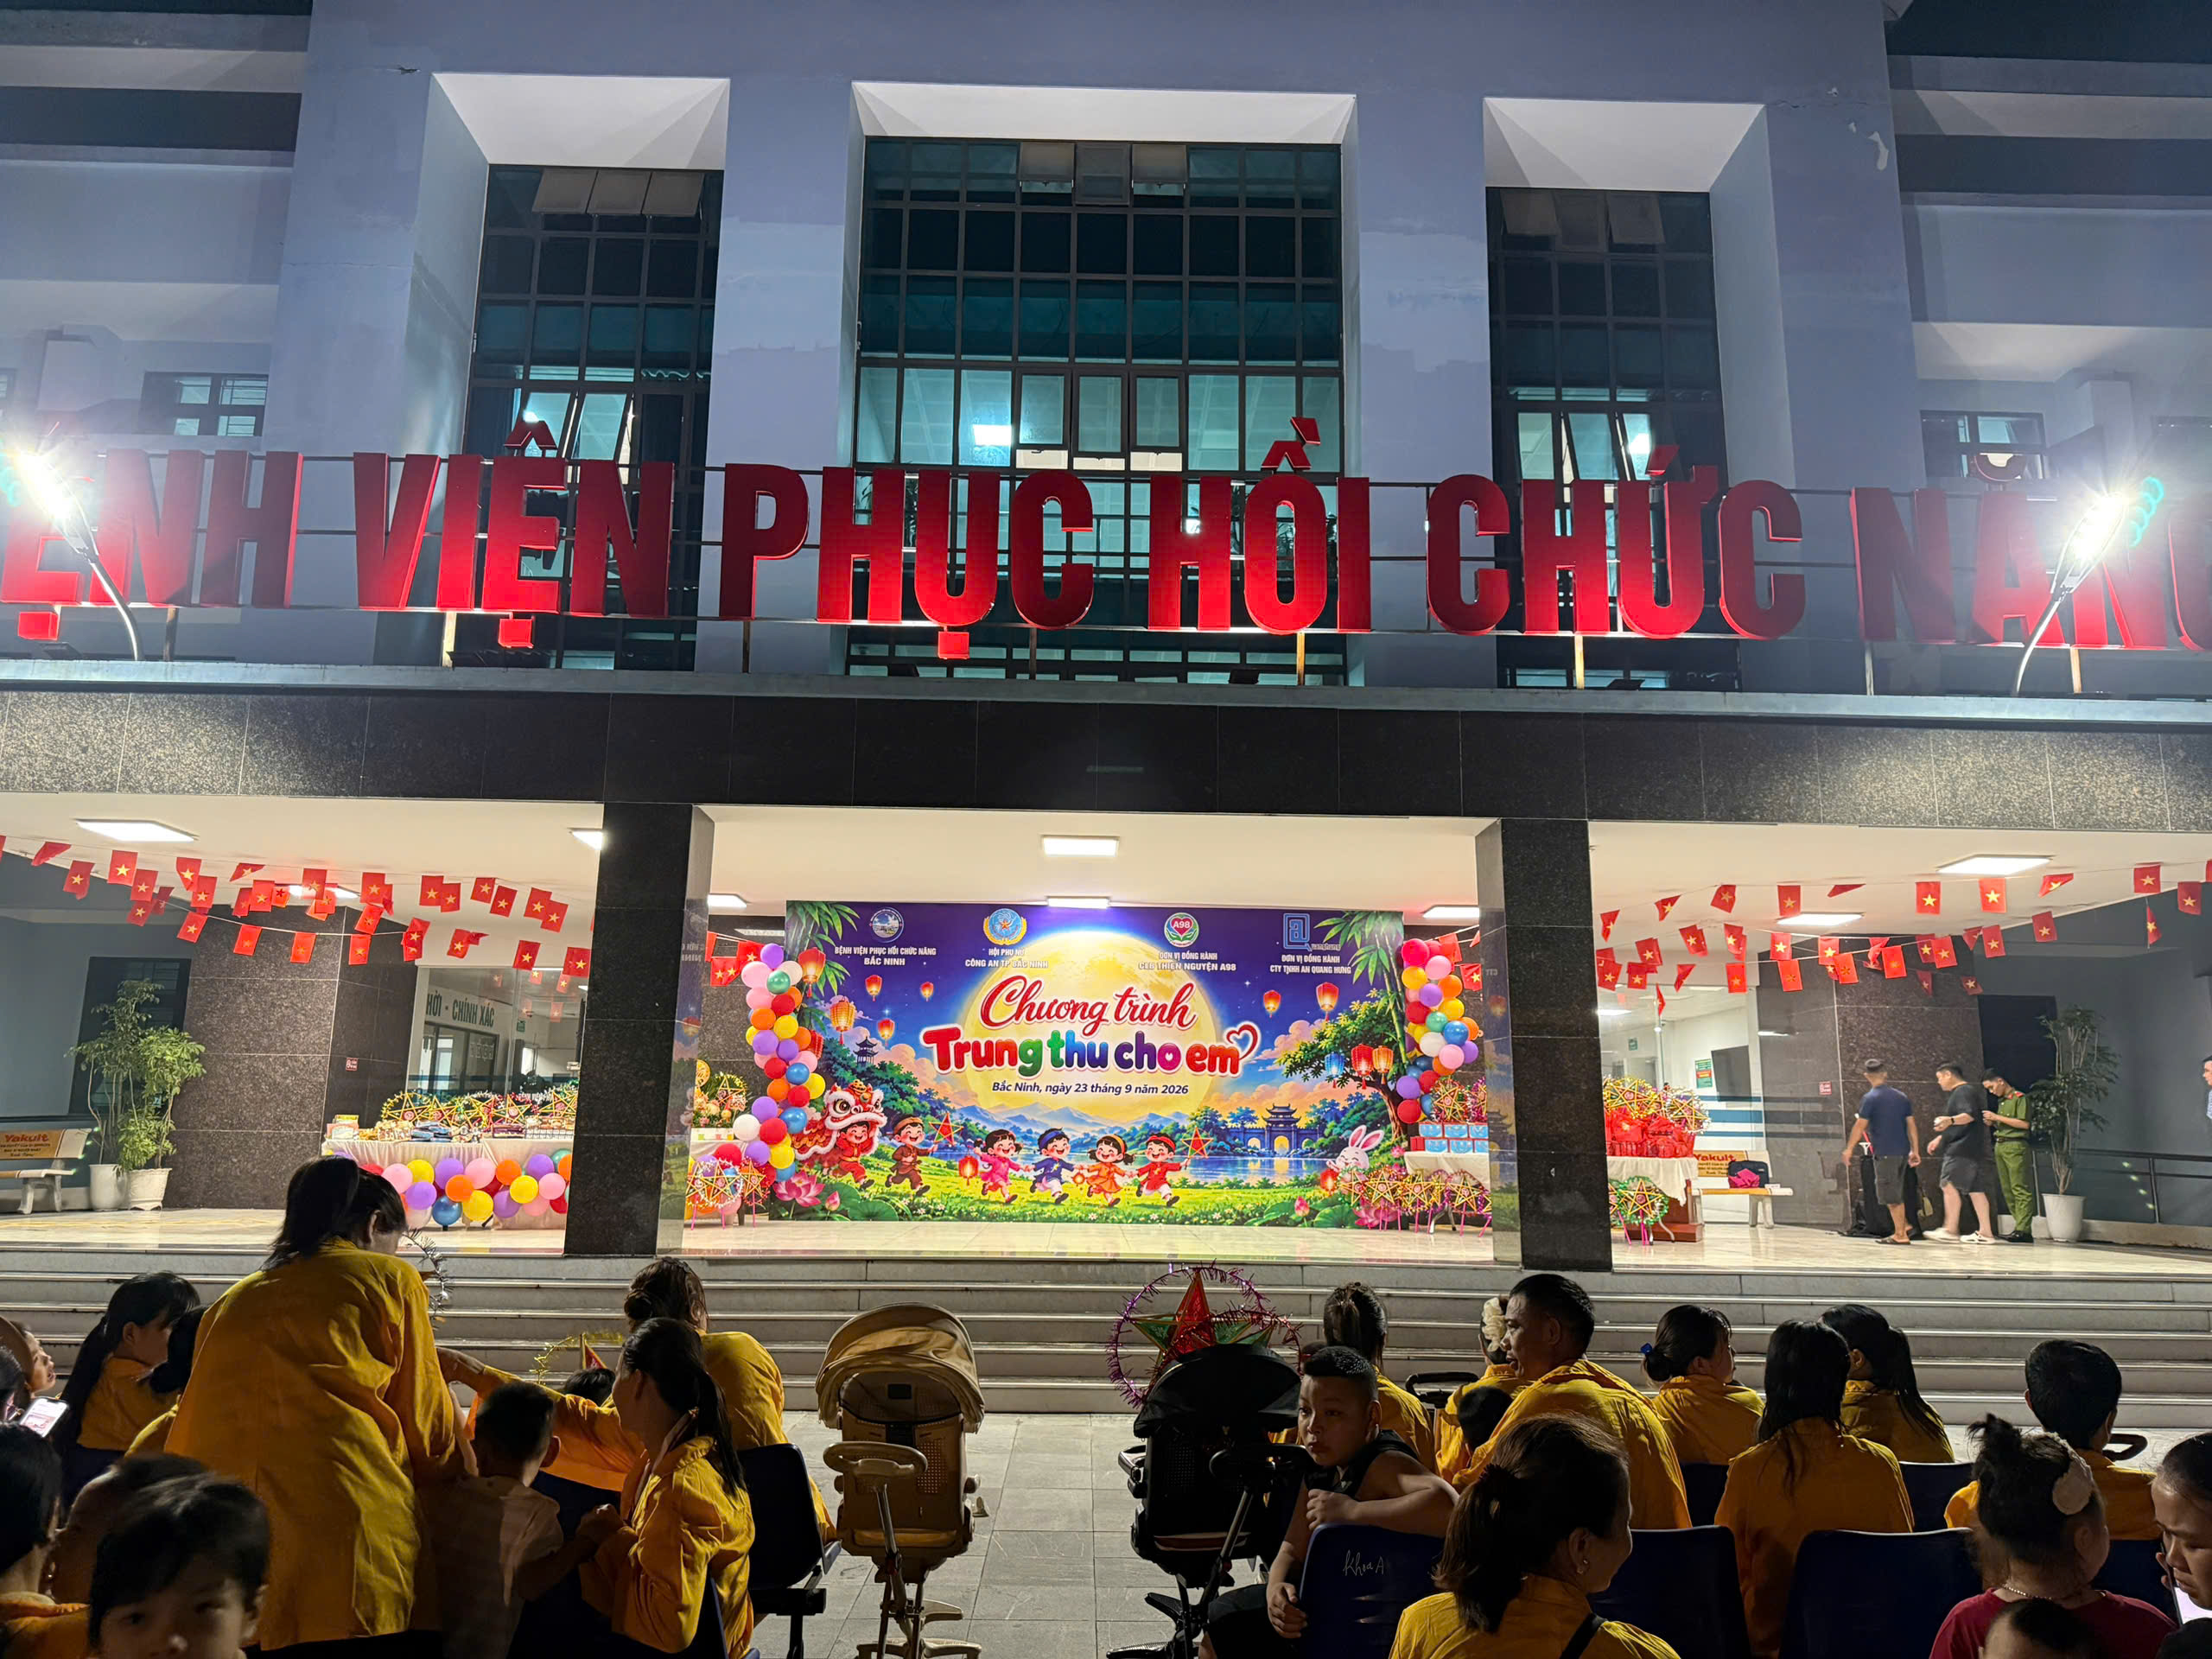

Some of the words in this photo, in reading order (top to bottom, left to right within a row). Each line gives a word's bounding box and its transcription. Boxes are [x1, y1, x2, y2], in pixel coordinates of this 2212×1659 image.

[353, 421, 675, 648] VIỆN
[719, 463, 1094, 659] PHỤC
[1147, 416, 1371, 635] HỒI
[1426, 445, 1807, 640] CHỨC
[1173, 920, 1191, 929] A98
[835, 945, 852, 956] BỆNH
[854, 945, 868, 956] VIỆN
[869, 946, 887, 957] PHỤC
[899, 945, 917, 956] CHỨC
[883, 957, 906, 966] NINH
[965, 957, 987, 968] CÔNG
[988, 959, 999, 968] AN
[1029, 960, 1049, 969] NINH
[1183, 962, 1218, 972] NGUYỆN
[1219, 963, 1236, 971] A98
[1269, 964, 1281, 973] CTY
[1300, 965, 1311, 974] AN
[1312, 965, 1333, 974] QUANG
[980, 976, 1109, 1035] Chương
[1115, 982, 1197, 1028] trình
[452, 996, 478, 1025] CHÍNH
[479, 1002, 495, 1028] XÁC
[922, 1027, 1044, 1077] Trung
[1046, 1029, 1108, 1071] thu
[1114, 1030, 1182, 1071] cho
[1185, 1041, 1241, 1075] em
[992, 1080, 1012, 1092] Bắc
[1014, 1082, 1042, 1094] Ninh,
[1046, 1082, 1072, 1095] ngày
[1074, 1083, 1088, 1093] 23
[1090, 1083, 1122, 1096] tháng
[1125, 1084, 1132, 1094] 9
[1135, 1084, 1159, 1095] năm
[1160, 1084, 1189, 1095] 2026
[4, 1133, 49, 1143] Yakult
[1694, 1153, 1737, 1162] Yakult
[1376, 1555, 1385, 1574] A
